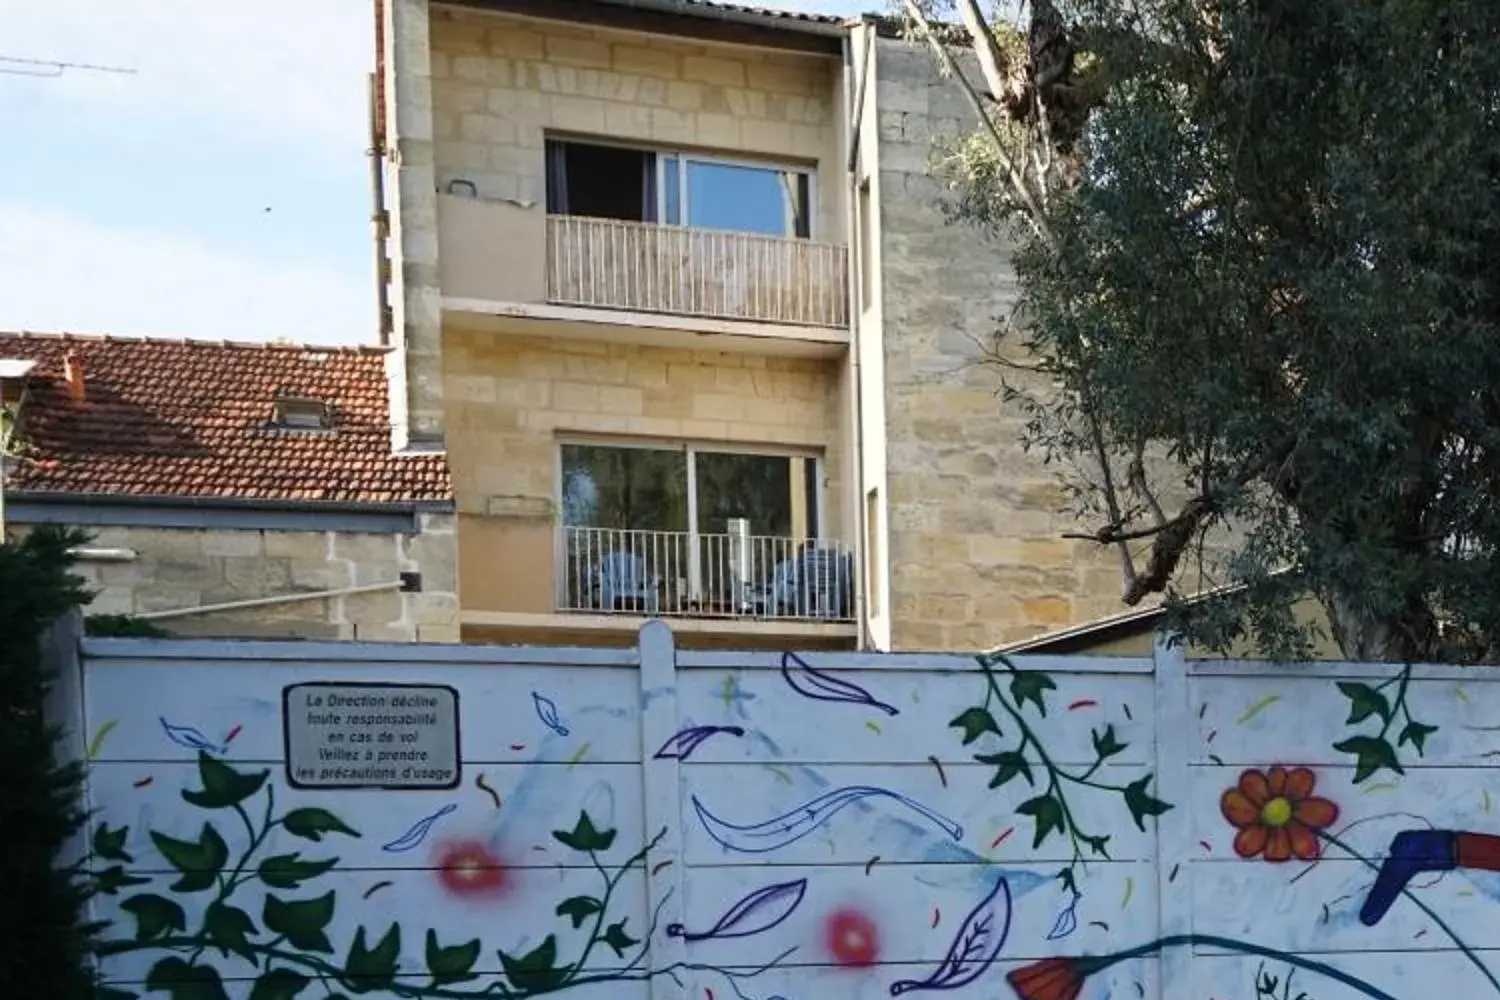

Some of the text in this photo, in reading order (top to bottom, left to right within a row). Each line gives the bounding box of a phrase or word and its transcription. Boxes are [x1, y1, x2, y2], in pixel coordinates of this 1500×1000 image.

[327, 694, 385, 707] Direction
[391, 694, 438, 707] décline
[307, 712, 437, 727] toute responsabilité
[328, 731, 419, 743] en cas de vol
[319, 748, 428, 763] Veillez à prendre
[296, 766, 453, 780] les précautions d'usage
